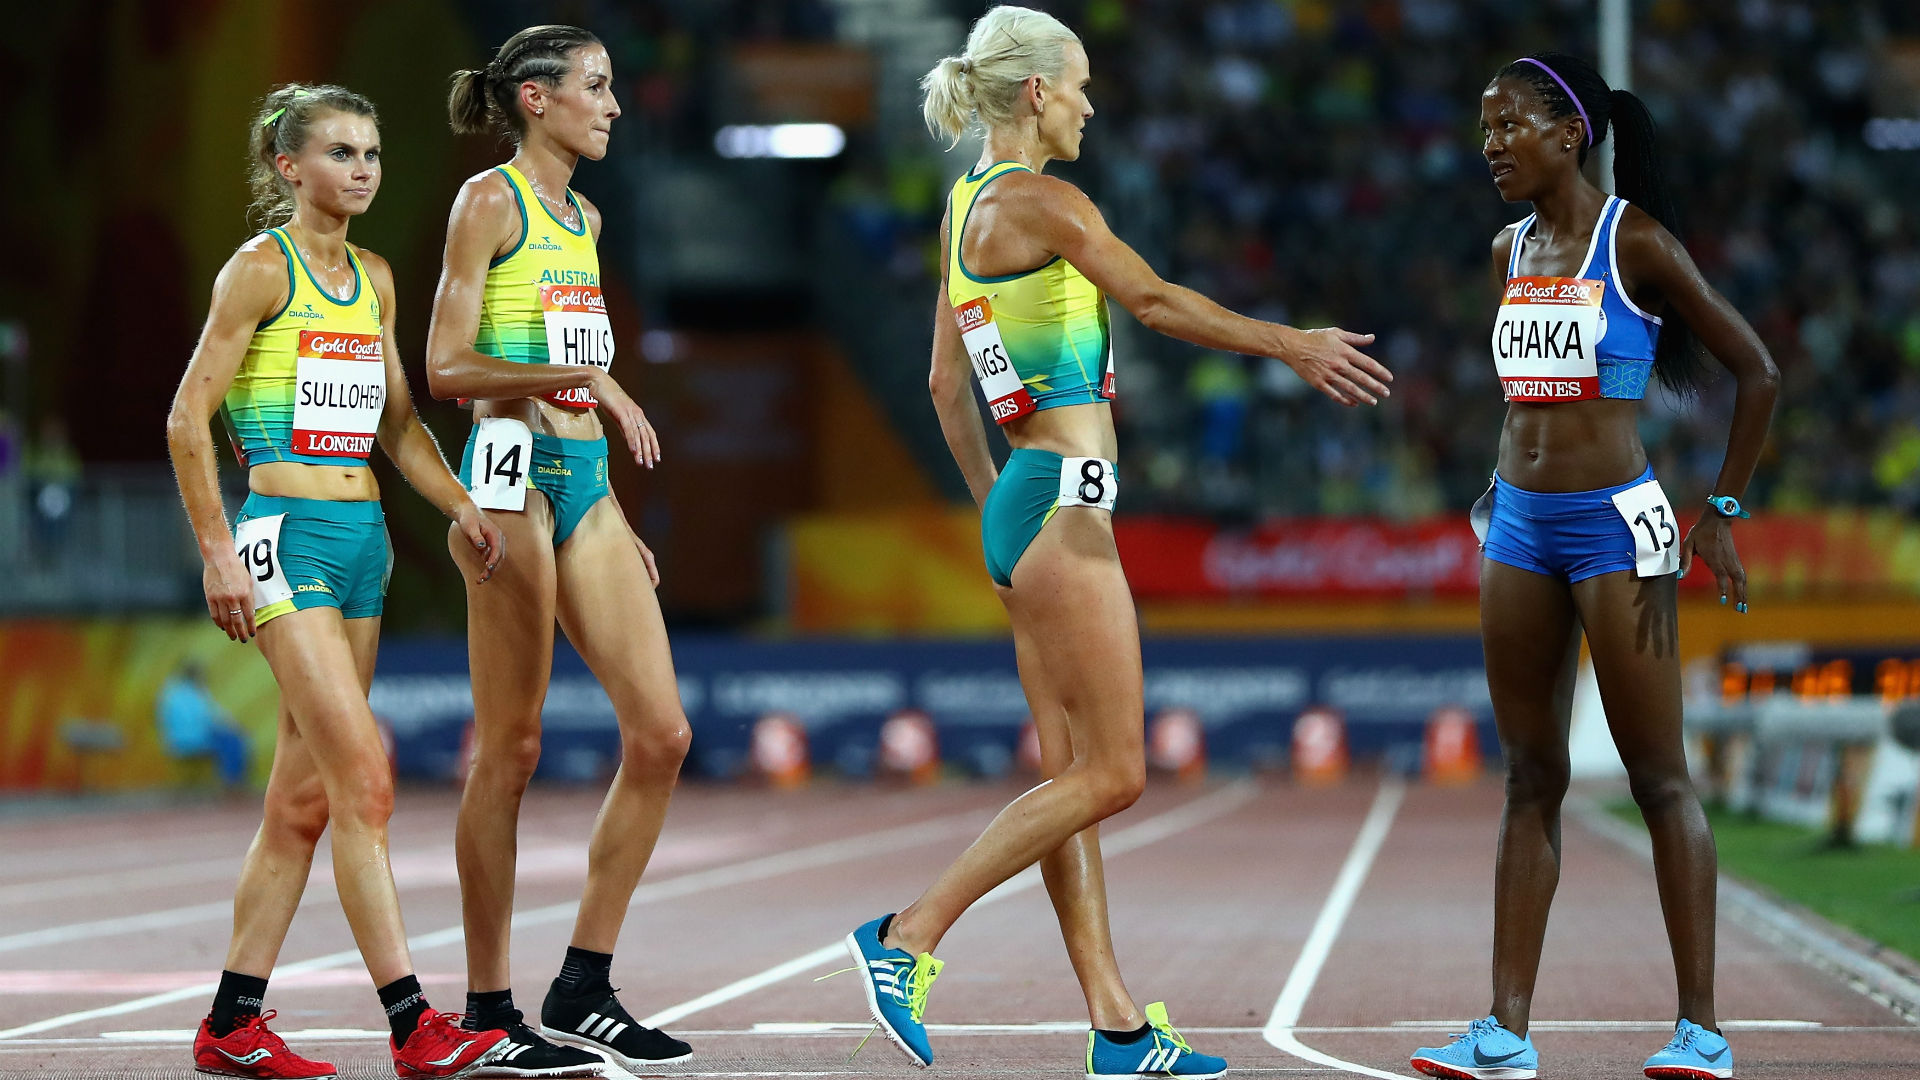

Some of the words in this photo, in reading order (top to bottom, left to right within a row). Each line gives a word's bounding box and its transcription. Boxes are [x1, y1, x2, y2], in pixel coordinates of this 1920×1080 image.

[528, 243, 563, 251] DIADORA
[551, 290, 581, 307] Gold
[1506, 282, 1524, 298] Gold
[1524, 282, 1557, 298] Coast
[1558, 284, 1591, 299] 2018
[288, 310, 325, 319] DIADORA
[964, 305, 984, 324] 2018
[310, 336, 348, 353] Gold
[348, 338, 375, 354] Coast
[564, 328, 609, 367] HILLS
[1498, 320, 1584, 360] CHAKA
[1503, 380, 1582, 397] LONGINES
[484, 442, 523, 487] 14
[537, 466, 573, 477] DIADORA
[1078, 459, 1105, 503] 8
[1634, 504, 1676, 552] 13
[238, 538, 275, 582] 19
